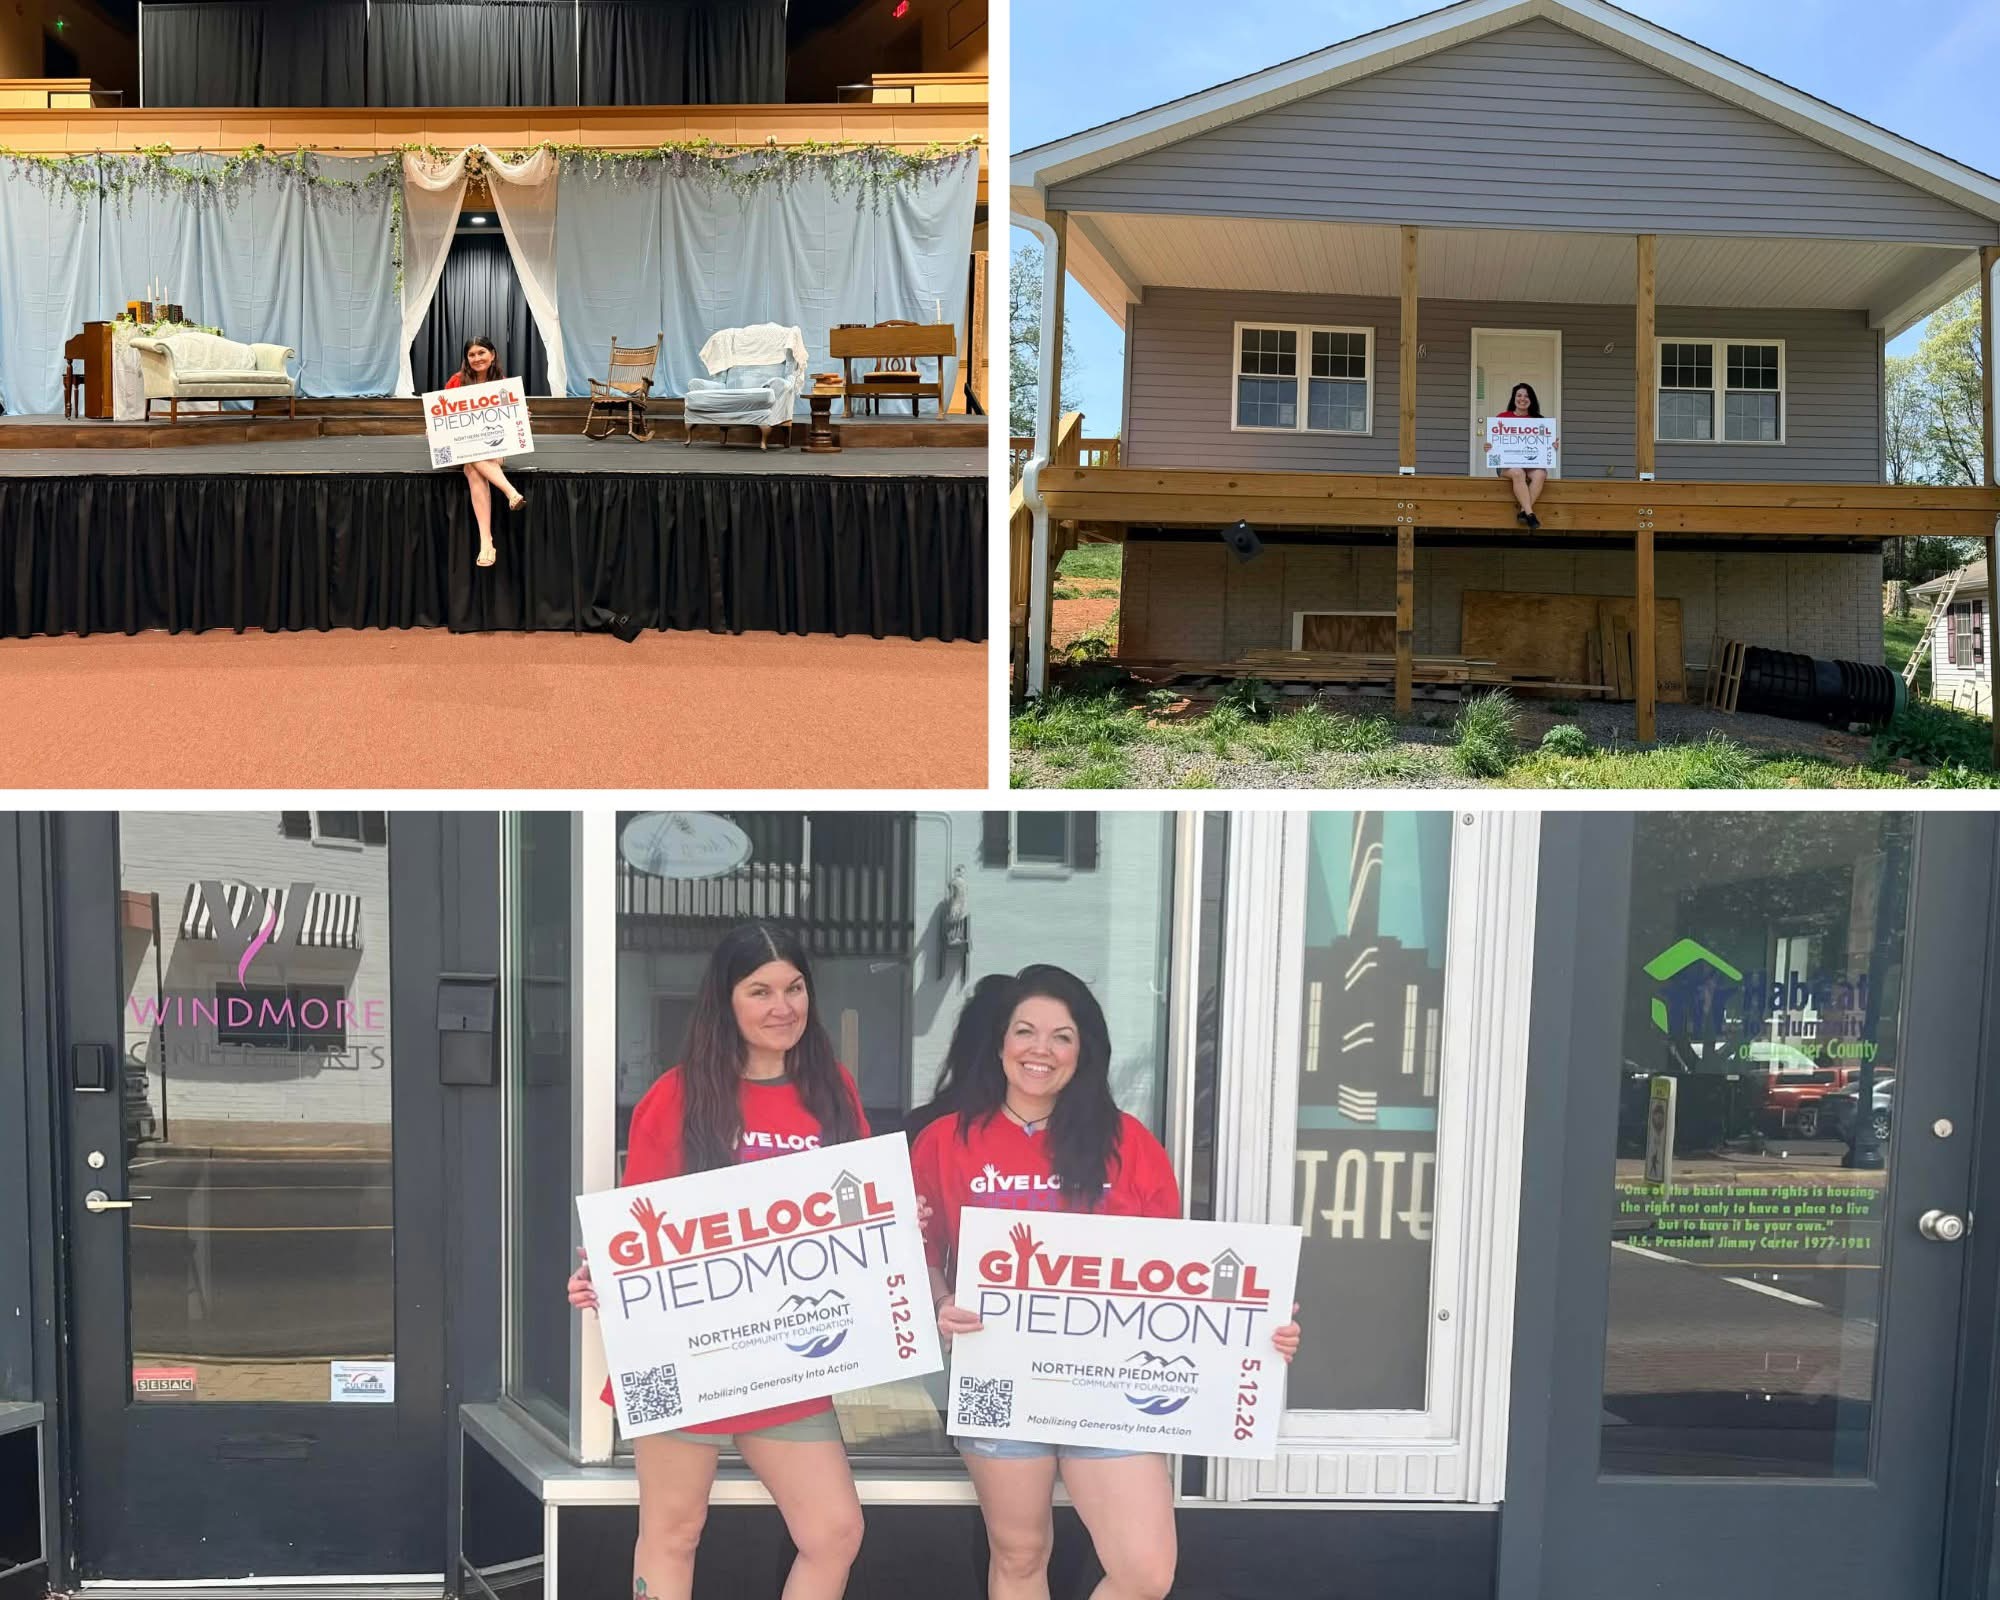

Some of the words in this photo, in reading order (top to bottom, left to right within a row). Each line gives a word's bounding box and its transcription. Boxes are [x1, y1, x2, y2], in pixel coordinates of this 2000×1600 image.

[430, 395, 468, 416] GIVE
[432, 404, 520, 432] PIEDMONT
[515, 420, 527, 449] 5.12.26
[1491, 420, 1517, 436] GIVE
[1492, 435, 1552, 445] PIEDMONT
[128, 996, 385, 1030] WINDMORE
[1826, 1038, 1878, 1062] County
[774, 1133, 821, 1151] LOC
[970, 1163, 1030, 1193] GIVE
[1652, 1184, 1665, 1195] of
[1669, 1184, 1689, 1196] the
[1693, 1184, 1723, 1196] basic
[1727, 1184, 1767, 1196] human
[1772, 1185, 1808, 1199] rights
[1812, 1185, 1823, 1196] is
[608, 1197, 733, 1266] GIVE
[738, 1169, 895, 1234] LOCAL
[1620, 1201, 1640, 1213] the
[1645, 1201, 1675, 1215] right
[1679, 1202, 1700, 1213] not
[1703, 1201, 1729, 1216] only
[1733, 1202, 1745, 1213] to
[1748, 1202, 1779, 1214] have
[1782, 1205, 1791, 1214] a
[1794, 1202, 1826, 1216] place
[1830, 1203, 1842, 1214] to
[1846, 1202, 1869, 1214] live
[1658, 1219, 1679, 1230] but
[1683, 1219, 1696, 1230] to
[1700, 1219, 1729, 1231] have
[1732, 1219, 1741, 1231] it
[1744, 1219, 1760, 1231] be
[1764, 1222, 1792, 1233] your
[1628, 1235, 1652, 1247] U.S.
[1655, 1236, 1714, 1248] President
[1717, 1236, 1756, 1251] Jimmy
[1760, 1236, 1799, 1249] Carter
[1804, 1236, 1871, 1249] 1977-1981
[618, 1220, 897, 1320] PIEDMONT
[978, 1221, 1102, 1289] GIVE
[1110, 1247, 1270, 1300] LOCAL
[688, 1319, 771, 1349] NORTHERN
[774, 1303, 851, 1330] PIEDMONT
[885, 1273, 917, 1360] 5.12.26
[979, 1290, 1269, 1347] PIEDMONT
[731, 1330, 791, 1351] COMMUNITY
[792, 1317, 854, 1338] FOUNDATION
[139, 1380, 191, 1390] SESAC
[698, 1384, 749, 1403] Mobilizing
[750, 1372, 804, 1391] Generosity
[805, 1368, 825, 1379] Into
[827, 1361, 859, 1375] Action
[1031, 1361, 1115, 1379] NORTHERN
[1118, 1367, 1199, 1385] PIEDMONT
[1071, 1378, 1131, 1390] COMMUNITY
[1134, 1382, 1199, 1395] FOUNDATION
[1233, 1357, 1261, 1441] 5.12.26
[1027, 1415, 1078, 1429] Mobilizing
[1079, 1418, 1135, 1434] Generosity
[1135, 1423, 1157, 1434] Into
[1158, 1425, 1192, 1436] Action
